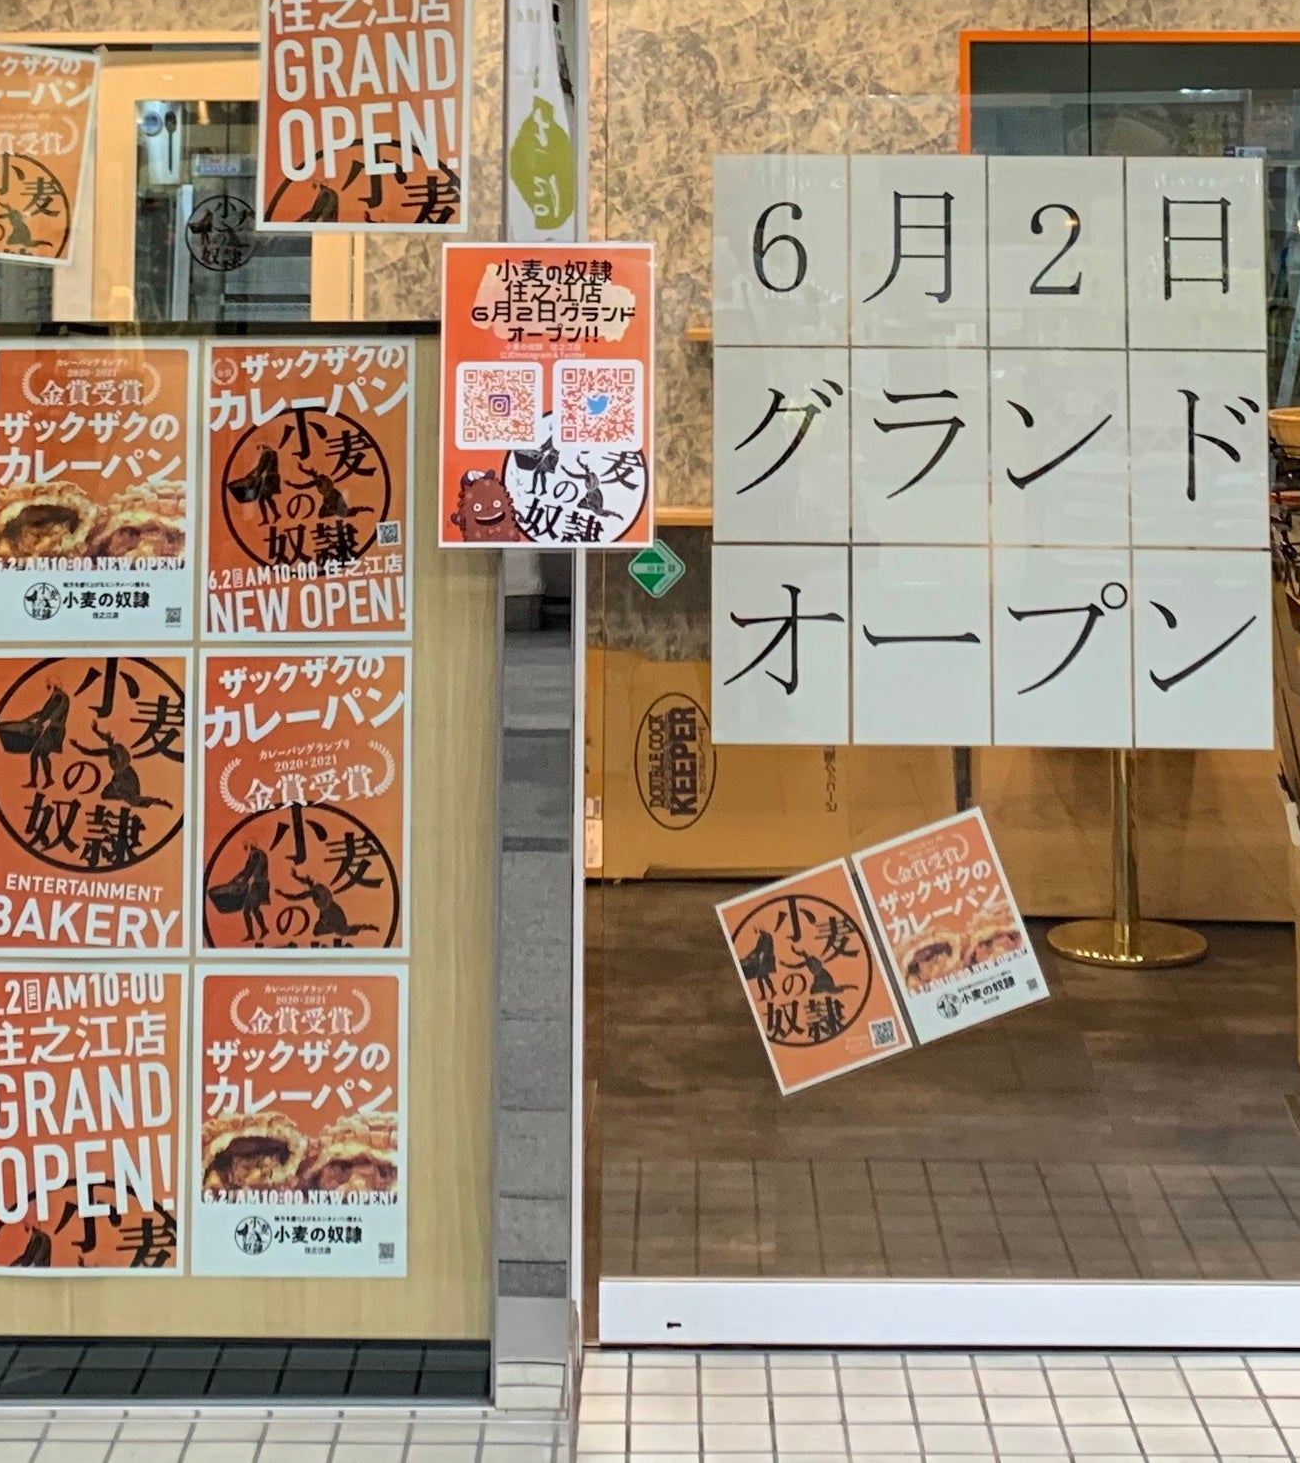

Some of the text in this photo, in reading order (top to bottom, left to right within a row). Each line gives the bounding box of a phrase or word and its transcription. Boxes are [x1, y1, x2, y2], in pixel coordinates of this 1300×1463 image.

[274, 28, 457, 103] GRAND
[279, 98, 459, 183] OPEN!
[751, 189, 1233, 304] 6月2日
[495, 259, 613, 284] 小麦の奴隷
[471, 300, 637, 324] 6月2日グランド
[504, 281, 602, 305] 住之江店
[506, 325, 600, 344] オープン!!
[241, 346, 406, 384] ザックザクの
[38, 379, 144, 406] 金賞受賞
[210, 376, 409, 433] カレーパン
[733, 378, 1261, 502] グランド
[286, 493, 315, 520] の
[553, 479, 579, 505] の
[208, 553, 404, 590] 6.2 AM10:00 住之江店
[62, 590, 151, 609] 小麦の奴隷
[208, 575, 407, 634] NEW OPEN!
[722, 581, 1258, 696] オープン
[218, 655, 386, 700] ザックザクの
[204, 687, 406, 749] カレーパン
[62, 761, 102, 795] の
[669, 706, 698, 817] KEEPER
[243, 764, 378, 813] 金賞受賞
[22, 792, 147, 869] 奴隷
[5, 873, 164, 904] ENTERTAINMENT
[877, 859, 991, 916] ザックザクの
[275, 905, 311, 937] の
[886, 884, 1002, 944] カレーパン
[44, 972, 165, 1013] AM10:00
[781, 972, 808, 997] の
[248, 1005, 354, 1035] 金賞受賞
[206, 1039, 391, 1075] ザックザクの
[205, 1076, 394, 1116] カレーパン
[273, 1225, 363, 1245] 小麦の奴隷
